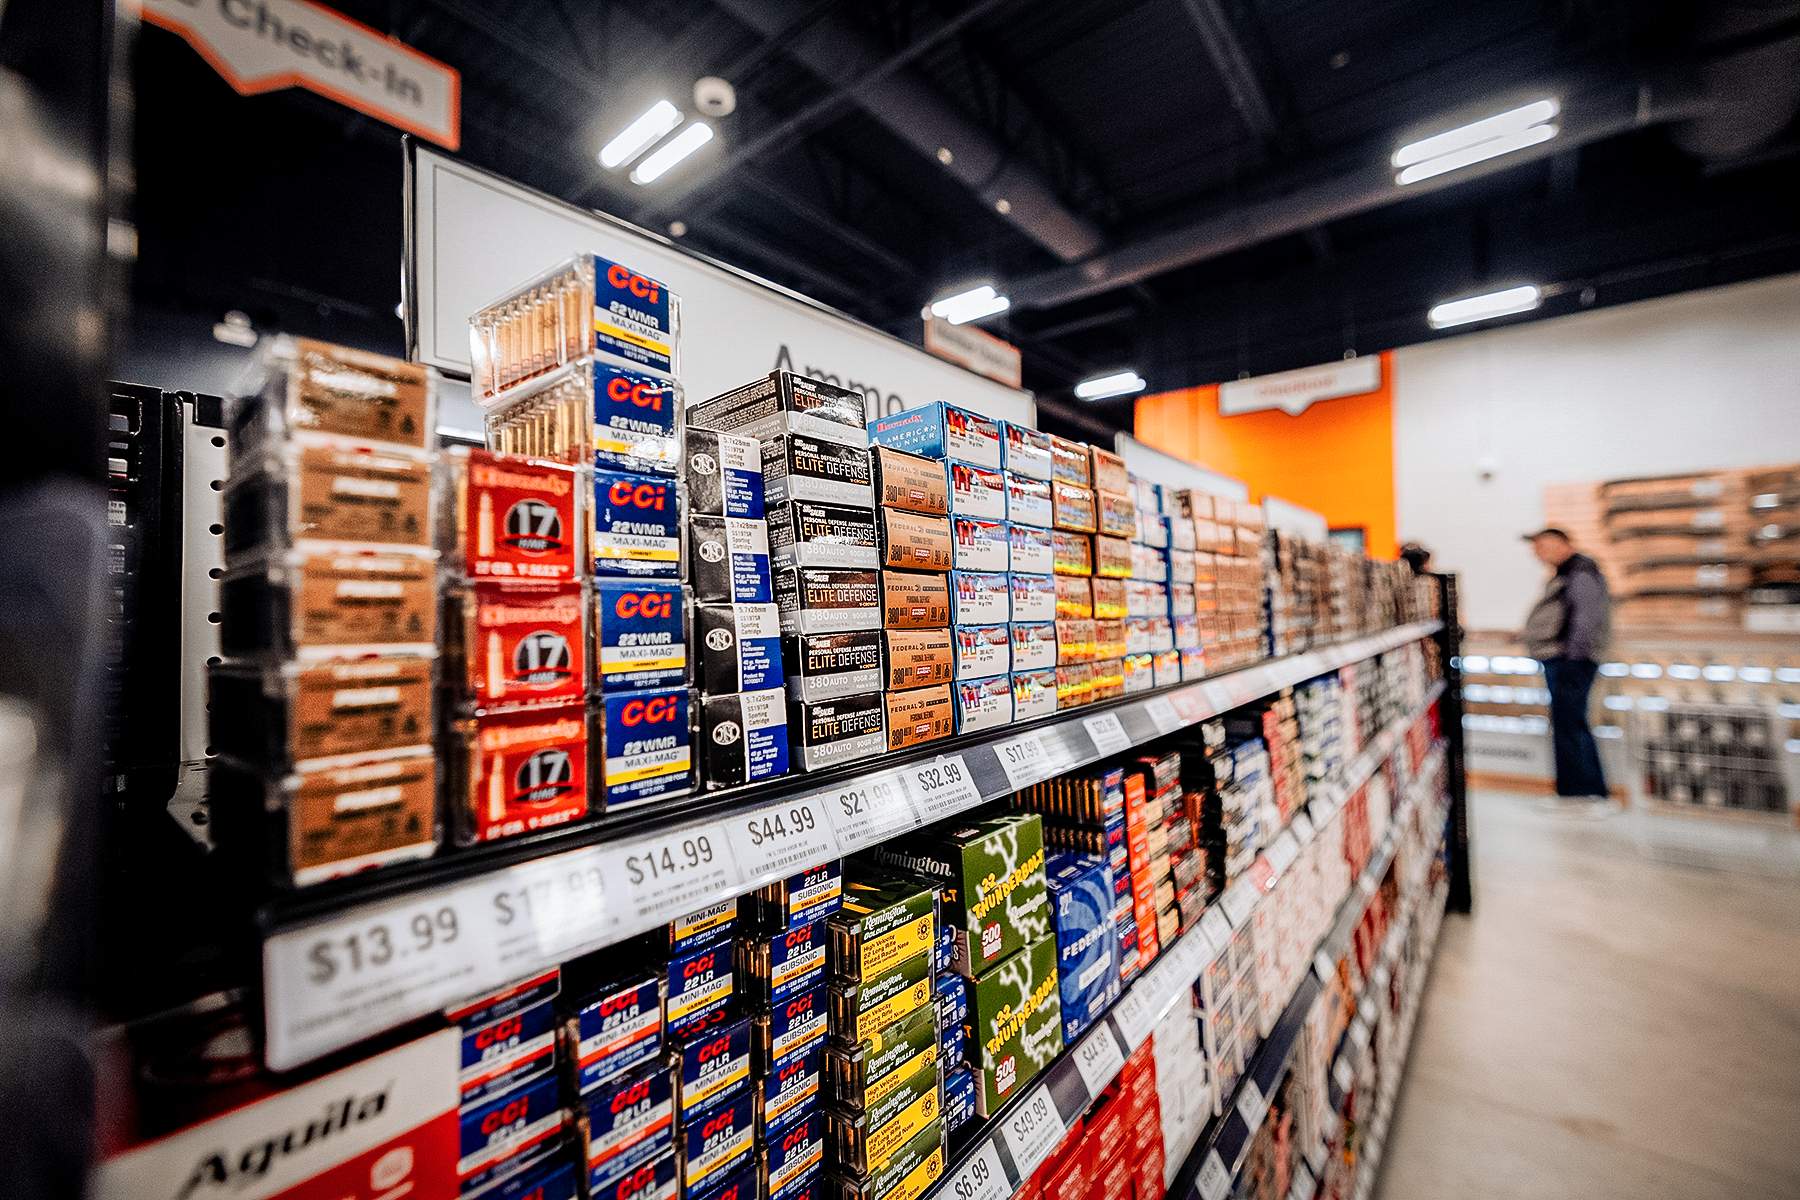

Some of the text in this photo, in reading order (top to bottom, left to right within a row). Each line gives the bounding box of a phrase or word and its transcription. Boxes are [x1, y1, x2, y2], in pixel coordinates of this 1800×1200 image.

[796, 456, 869, 480] ELITE DEFENSE
[516, 502, 557, 538] 17
[803, 516, 827, 525] PERSONAL
[805, 523, 874, 540] ELITE DEFENSE
[807, 589, 878, 603] ELITE DEFENSE
[526, 636, 567, 671] 17
[809, 647, 832, 656] PERSONAL
[833, 646, 852, 654] DEFENSE
[809, 650, 878, 670] ELITE DEFENSE
[892, 644, 919, 652] FEDERAL
[812, 716, 836, 726] PERSONAL
[836, 712, 856, 721] DEFENSE
[890, 704, 918, 714] FEDERAL
[812, 713, 881, 739] ELITE DEFENSE
[1005, 740, 1041, 763] $17.99
[529, 752, 569, 788] 17
[917, 763, 962, 792] $32.99
[748, 806, 815, 846] $44.99
[626, 835, 713, 886] $14.99
[873, 845, 952, 877] Remington
[798, 880, 834, 900] SUBSONIC
[804, 870, 828, 888] 22 LR
[971, 848, 1044, 920] THUNDERBOLT
[982, 873, 996, 894] 22
[801, 893, 831, 908] SMALL GAME
[685, 903, 727, 926] MINI-MAG
[692, 918, 718, 932] VARMINT
[864, 905, 907, 930] Remington
[892, 914, 914, 927] BULLET
[307, 906, 460, 985] $13.99
[864, 935, 896, 952] High Velocity
[982, 923, 1001, 946] 500
[1063, 923, 1107, 961] FEDERAL
[787, 940, 812, 960] 22 LR
[864, 941, 897, 960] 22 Long Rifle
[864, 941, 910, 967] Plated Round Nose
[780, 951, 818, 975] SUBSONIC
[680, 980, 722, 1005] MINI-MAG
[684, 970, 714, 991] 22 LR
[860, 973, 902, 1002] Remington
[860, 980, 909, 1012] GOLDEN BULLET
[788, 1009, 813, 1032] 22 LR
[860, 1003, 892, 1024] High Velocity
[860, 1009, 893, 1030] 22 Long Rifle
[860, 1008, 906, 1038] Plated Round Nose
[986, 967, 1058, 1056] THUNDERBOLT
[996, 1004, 1011, 1028] 22
[593, 1017, 647, 1047] MINI-MAG
[781, 1019, 819, 1045] SUBSONIC
[699, 1052, 730, 1077] 22 LR
[866, 1041, 909, 1075] Remington
[866, 1048, 915, 1085] GOLDEN BULLET
[995, 1056, 1015, 1082] 500
[695, 1063, 740, 1091] MINI-MAG
[780, 1069, 805, 1093] 22 LR
[867, 1074, 899, 1097] High Velocity
[773, 1078, 811, 1108] SUBSONIC
[871, 1087, 912, 1123] Remington
[634, 1098, 651, 1117] LR
[1013, 1097, 1049, 1142] $49.99
[172, 1078, 397, 1200] Aguila
[703, 1125, 734, 1152] 22 LR
[870, 1122, 914, 1160] Plated Round Nose
[699, 1135, 744, 1168] MINI-MAG
[777, 1146, 815, 1178] SUBSONIC
[875, 1150, 916, 1191] Remington
[955, 1157, 990, 1200] $6.99
[907, 1186, 920, 1198] Nose
